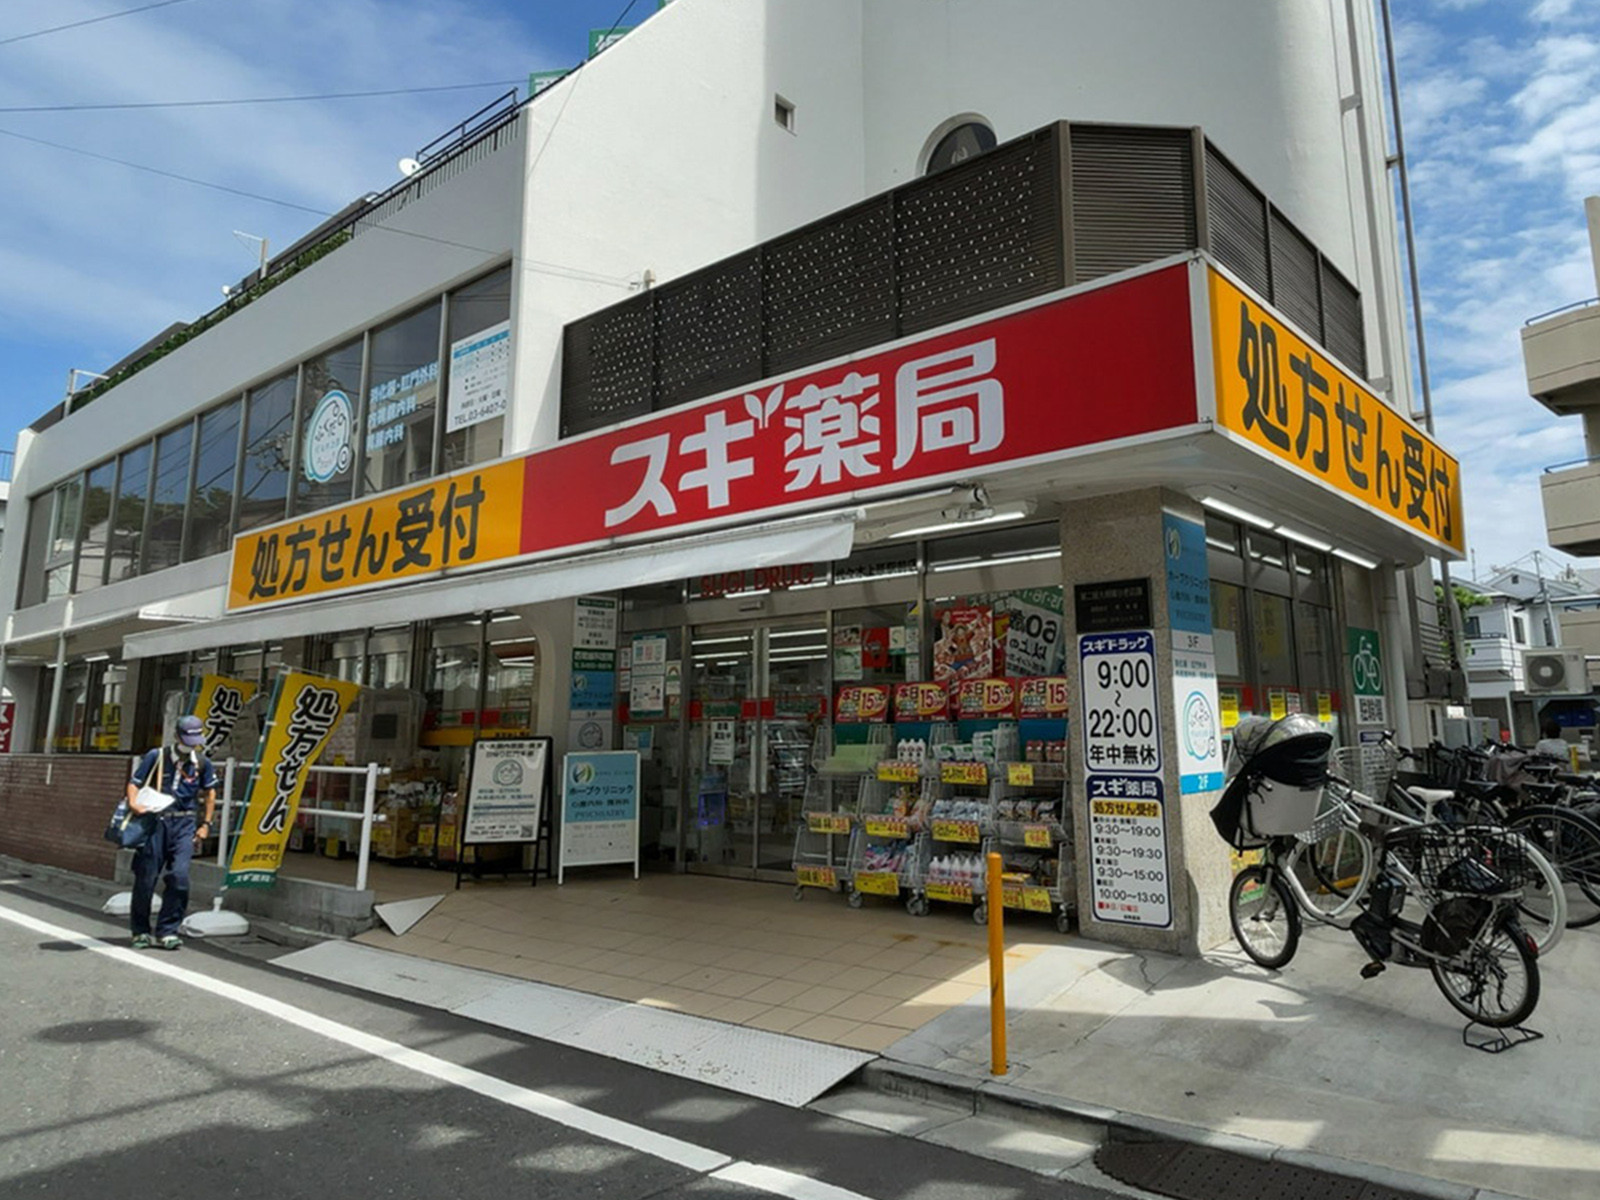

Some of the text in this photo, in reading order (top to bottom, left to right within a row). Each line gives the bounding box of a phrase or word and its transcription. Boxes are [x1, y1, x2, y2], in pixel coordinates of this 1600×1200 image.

[604, 337, 1005, 528] スギ薬局
[1238, 300, 1451, 541] 処方せん受付
[248, 475, 485, 600] 処方せん受付
[754, 563, 814, 590] DRUG
[1083, 636, 1150, 653] スギドラッグ
[1097, 659, 1150, 689] 9:00
[1089, 708, 1153, 738] 22:00
[259, 684, 340, 834] 処方せん
[1089, 744, 1156, 765] 年中無休
[568, 784, 634, 796] ホープクリニック
[1092, 778, 1158, 796] スギ薬局
[1198, 774, 1209, 790] 2F
[1093, 801, 1160, 817] 処方せん受付
